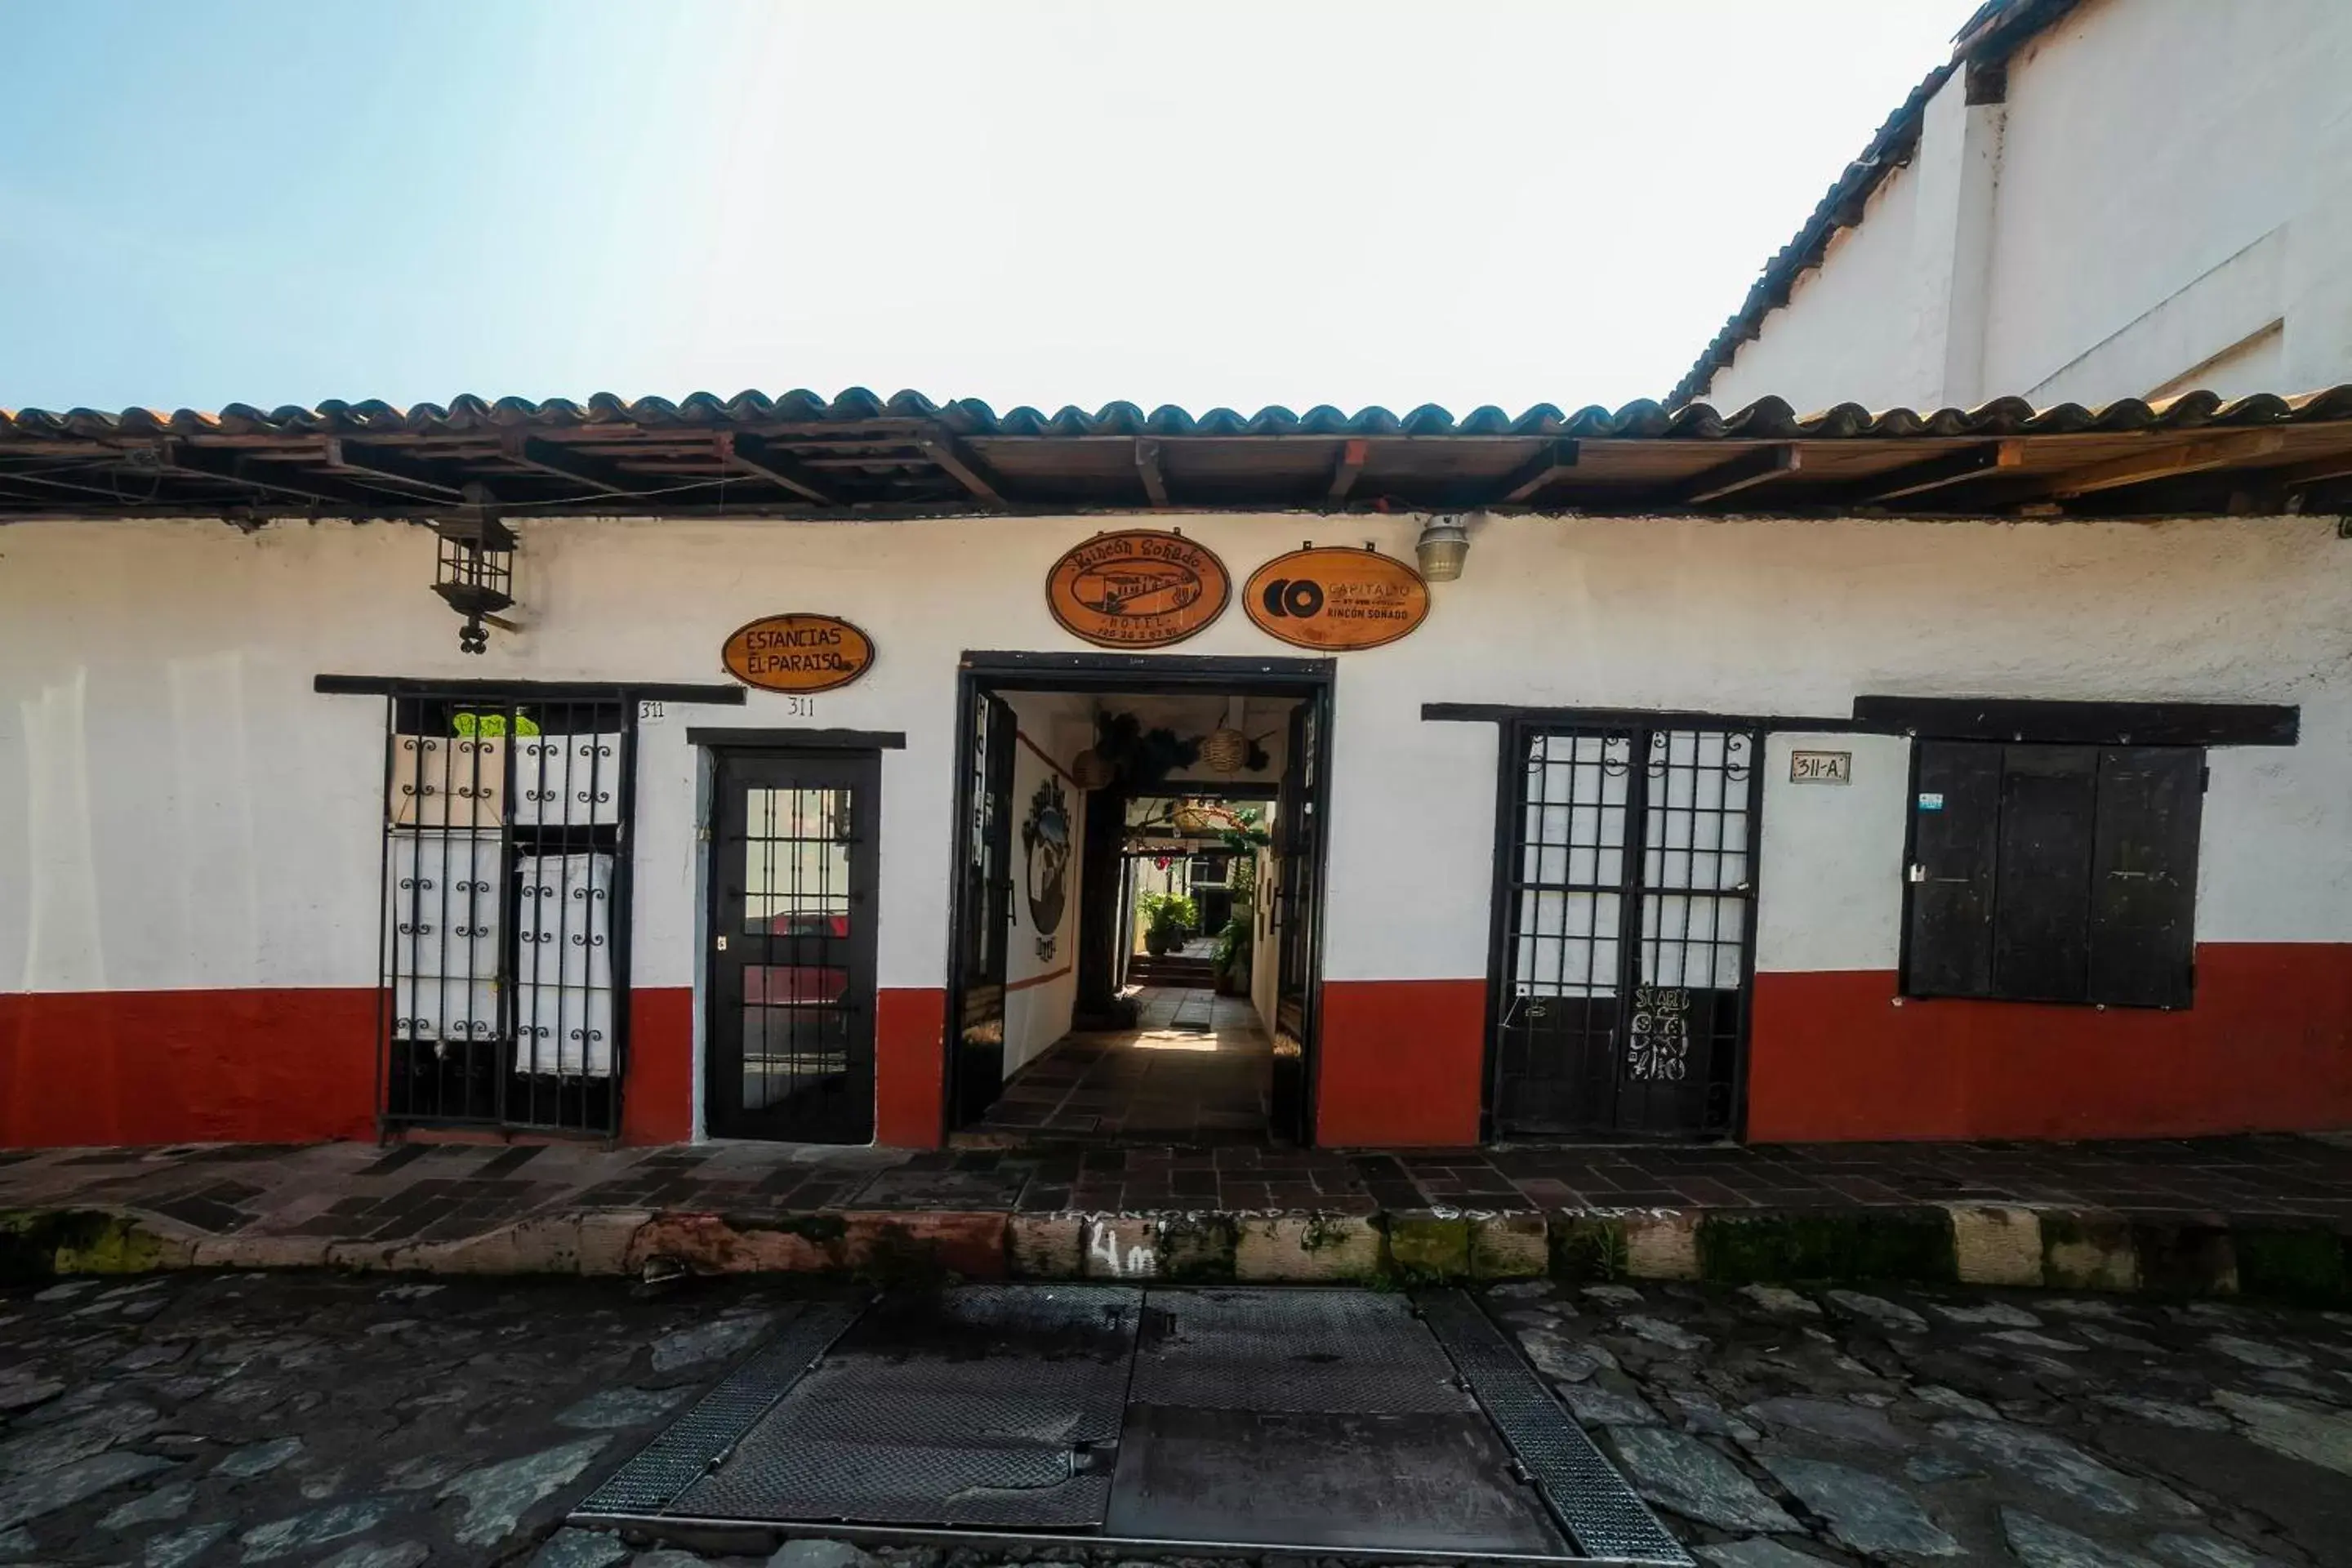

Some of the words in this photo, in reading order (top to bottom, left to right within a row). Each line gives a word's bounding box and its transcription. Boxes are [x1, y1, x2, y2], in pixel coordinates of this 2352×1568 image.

[1109, 617, 1163, 630] HOTEL
[746, 627, 842, 650] ESTANCIAS
[748, 656, 766, 675] EL
[768, 653, 843, 672] PARAISO
[639, 702, 665, 719] 311
[788, 696, 814, 716] 311
[1797, 758, 1838, 777] 311-A
